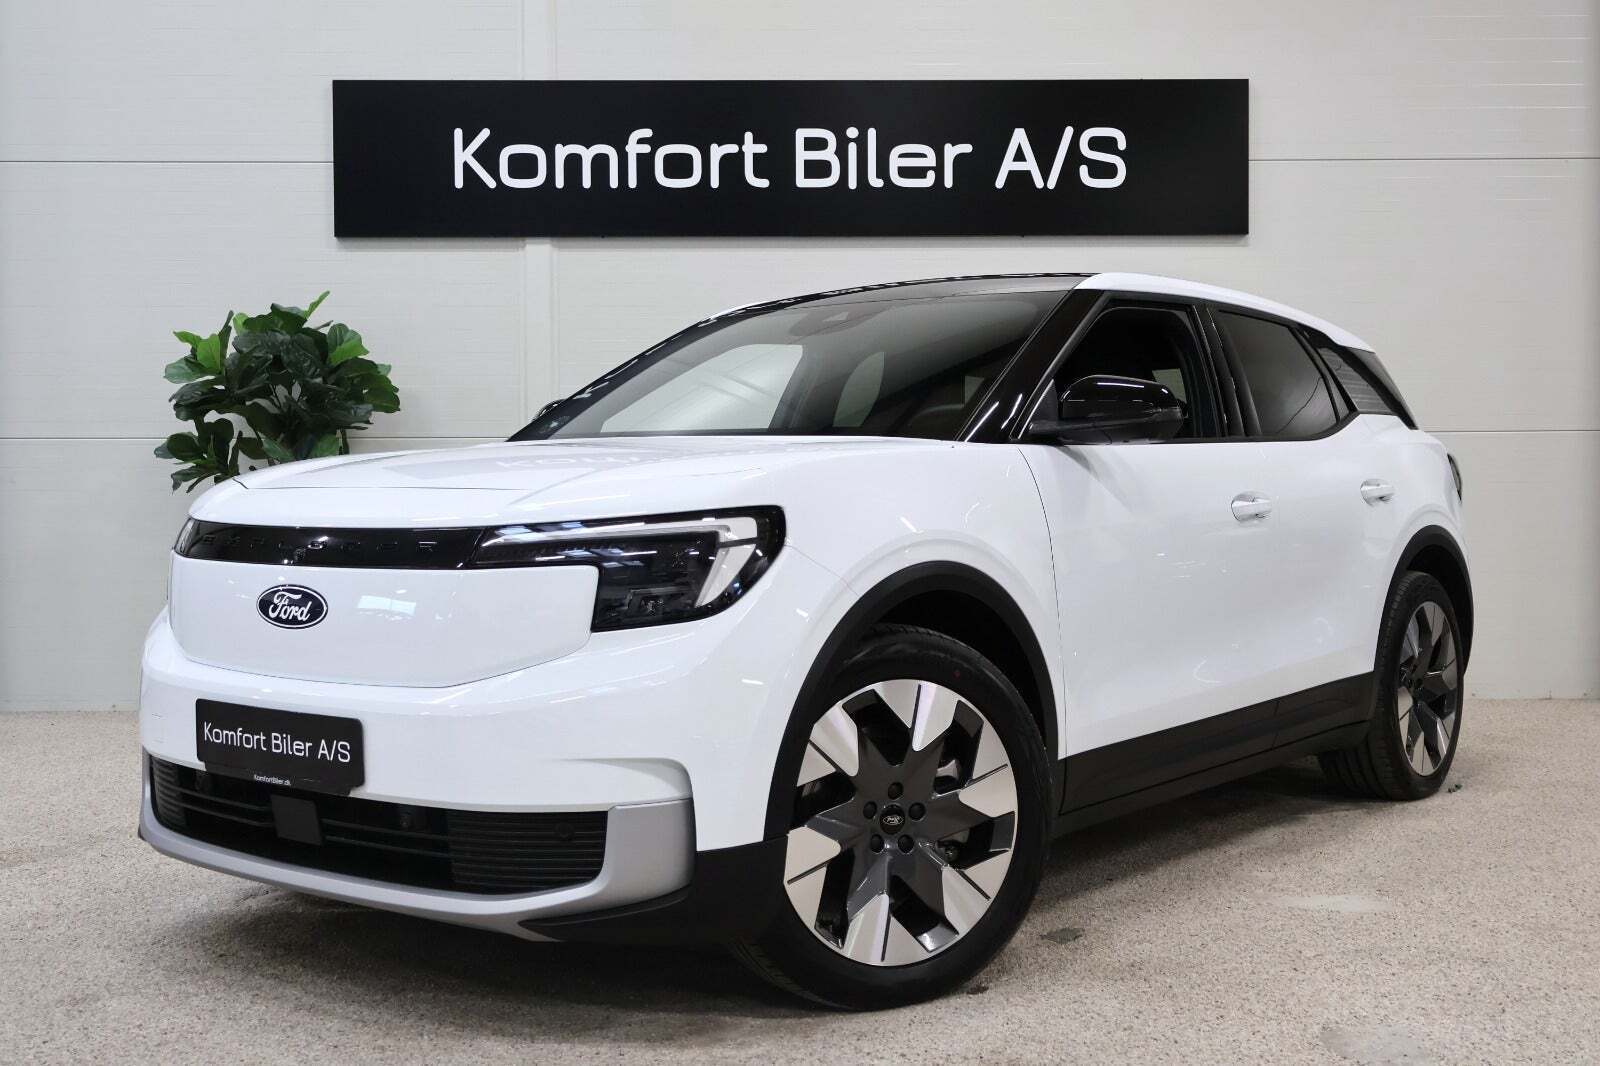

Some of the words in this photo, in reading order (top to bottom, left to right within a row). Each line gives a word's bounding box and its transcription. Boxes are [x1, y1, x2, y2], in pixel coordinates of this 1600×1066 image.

[453, 127, 770, 190] Komfort
[795, 126, 973, 190] Biler
[994, 125, 1127, 190] A/S
[269, 591, 311, 622] Ford
[203, 721, 267, 751] Komfort
[271, 732, 313, 757] Biler
[317, 739, 351, 763] A/S
